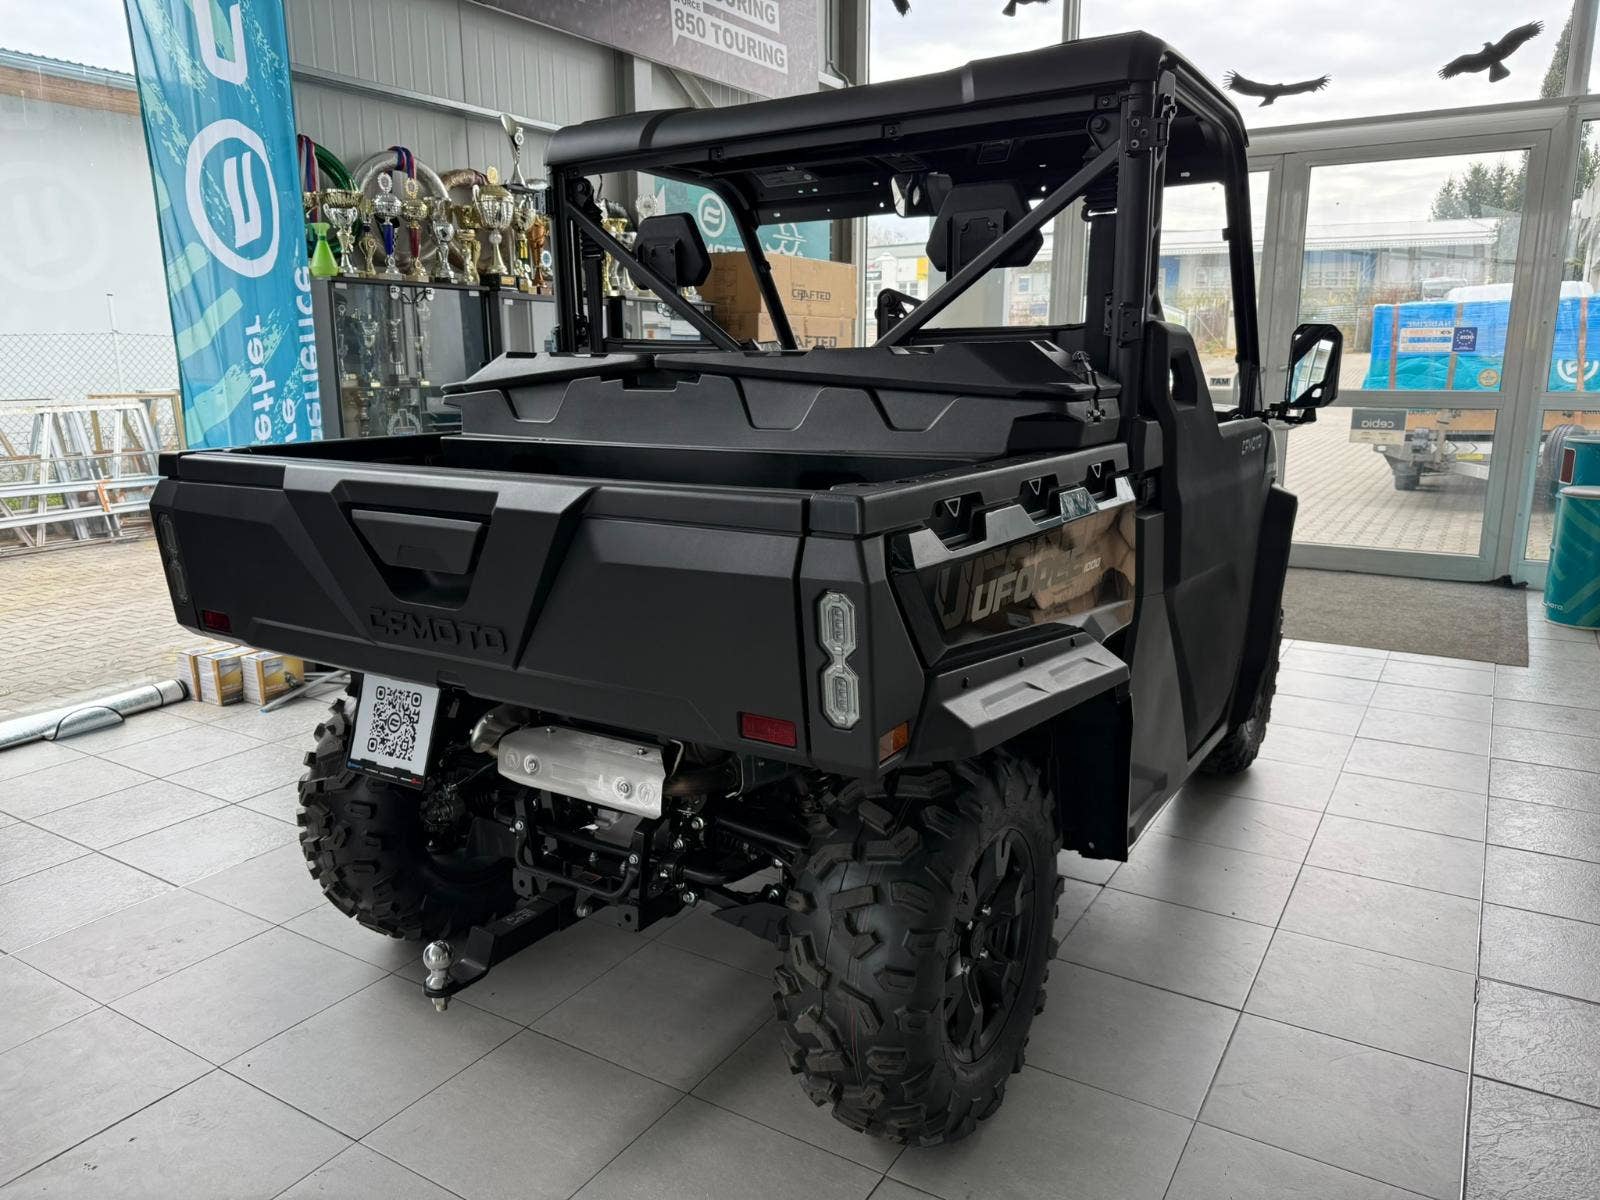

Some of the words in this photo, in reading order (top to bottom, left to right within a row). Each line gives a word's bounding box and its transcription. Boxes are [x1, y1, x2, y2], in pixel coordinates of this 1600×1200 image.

[674, 8, 706, 39] 850
[711, 22, 785, 68] TOURING
[1210, 377, 1231, 386] TAM
[369, 606, 509, 653] CFMOTO
